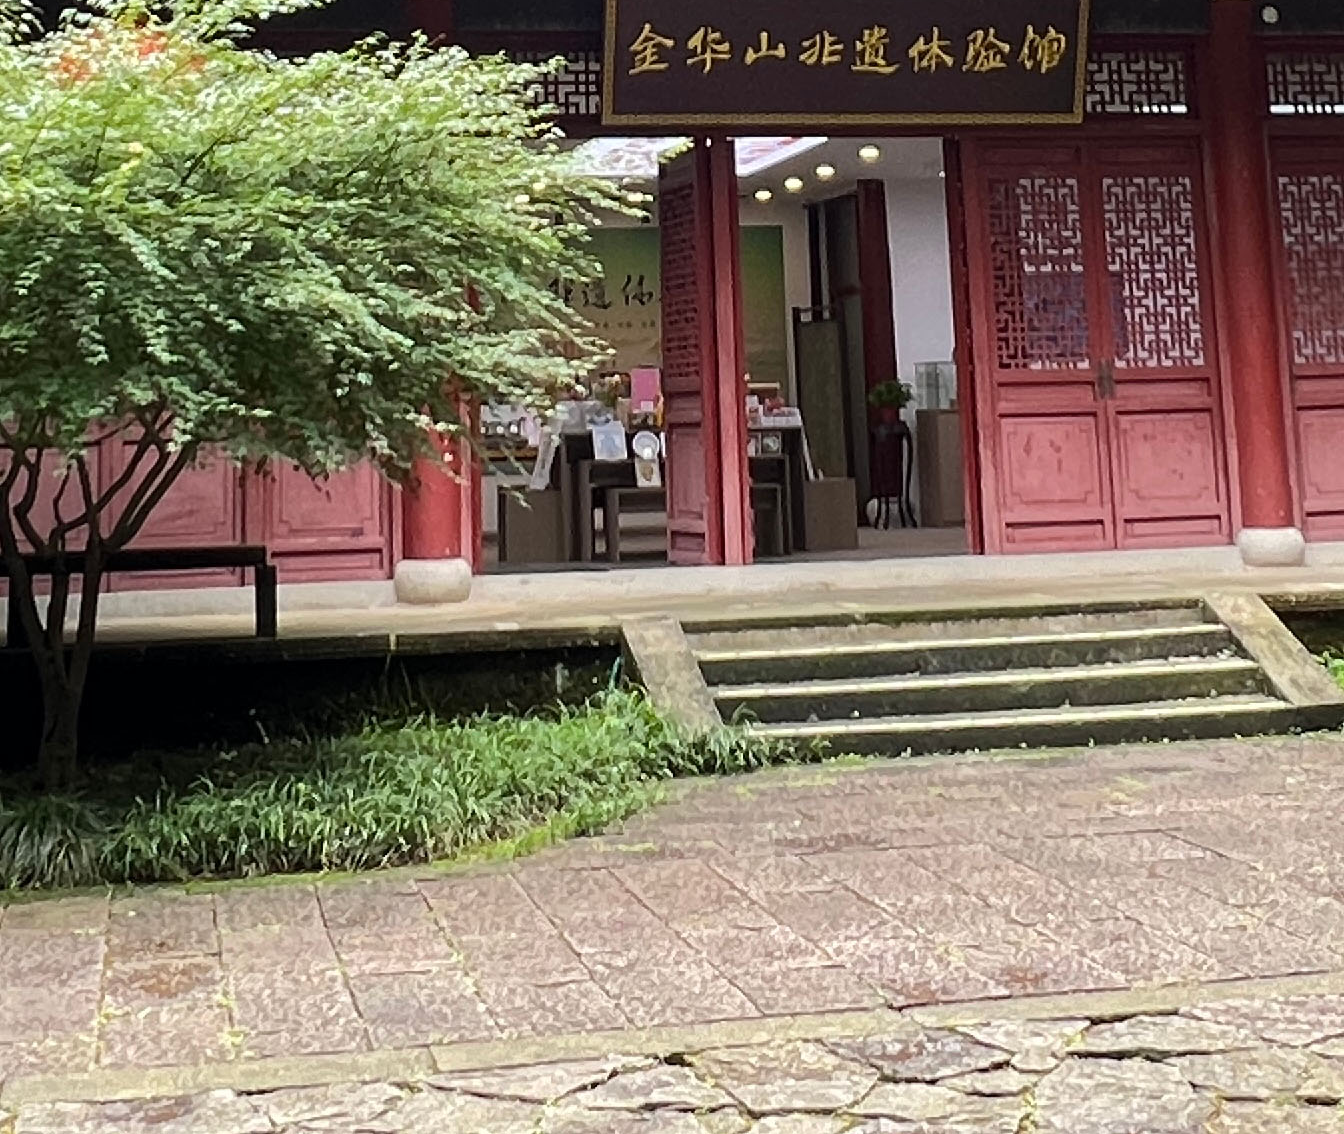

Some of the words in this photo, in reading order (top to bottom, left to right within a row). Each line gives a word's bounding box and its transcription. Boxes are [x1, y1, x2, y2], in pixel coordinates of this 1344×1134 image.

[628, 22, 1066, 76] 金华山非遗体验馆
